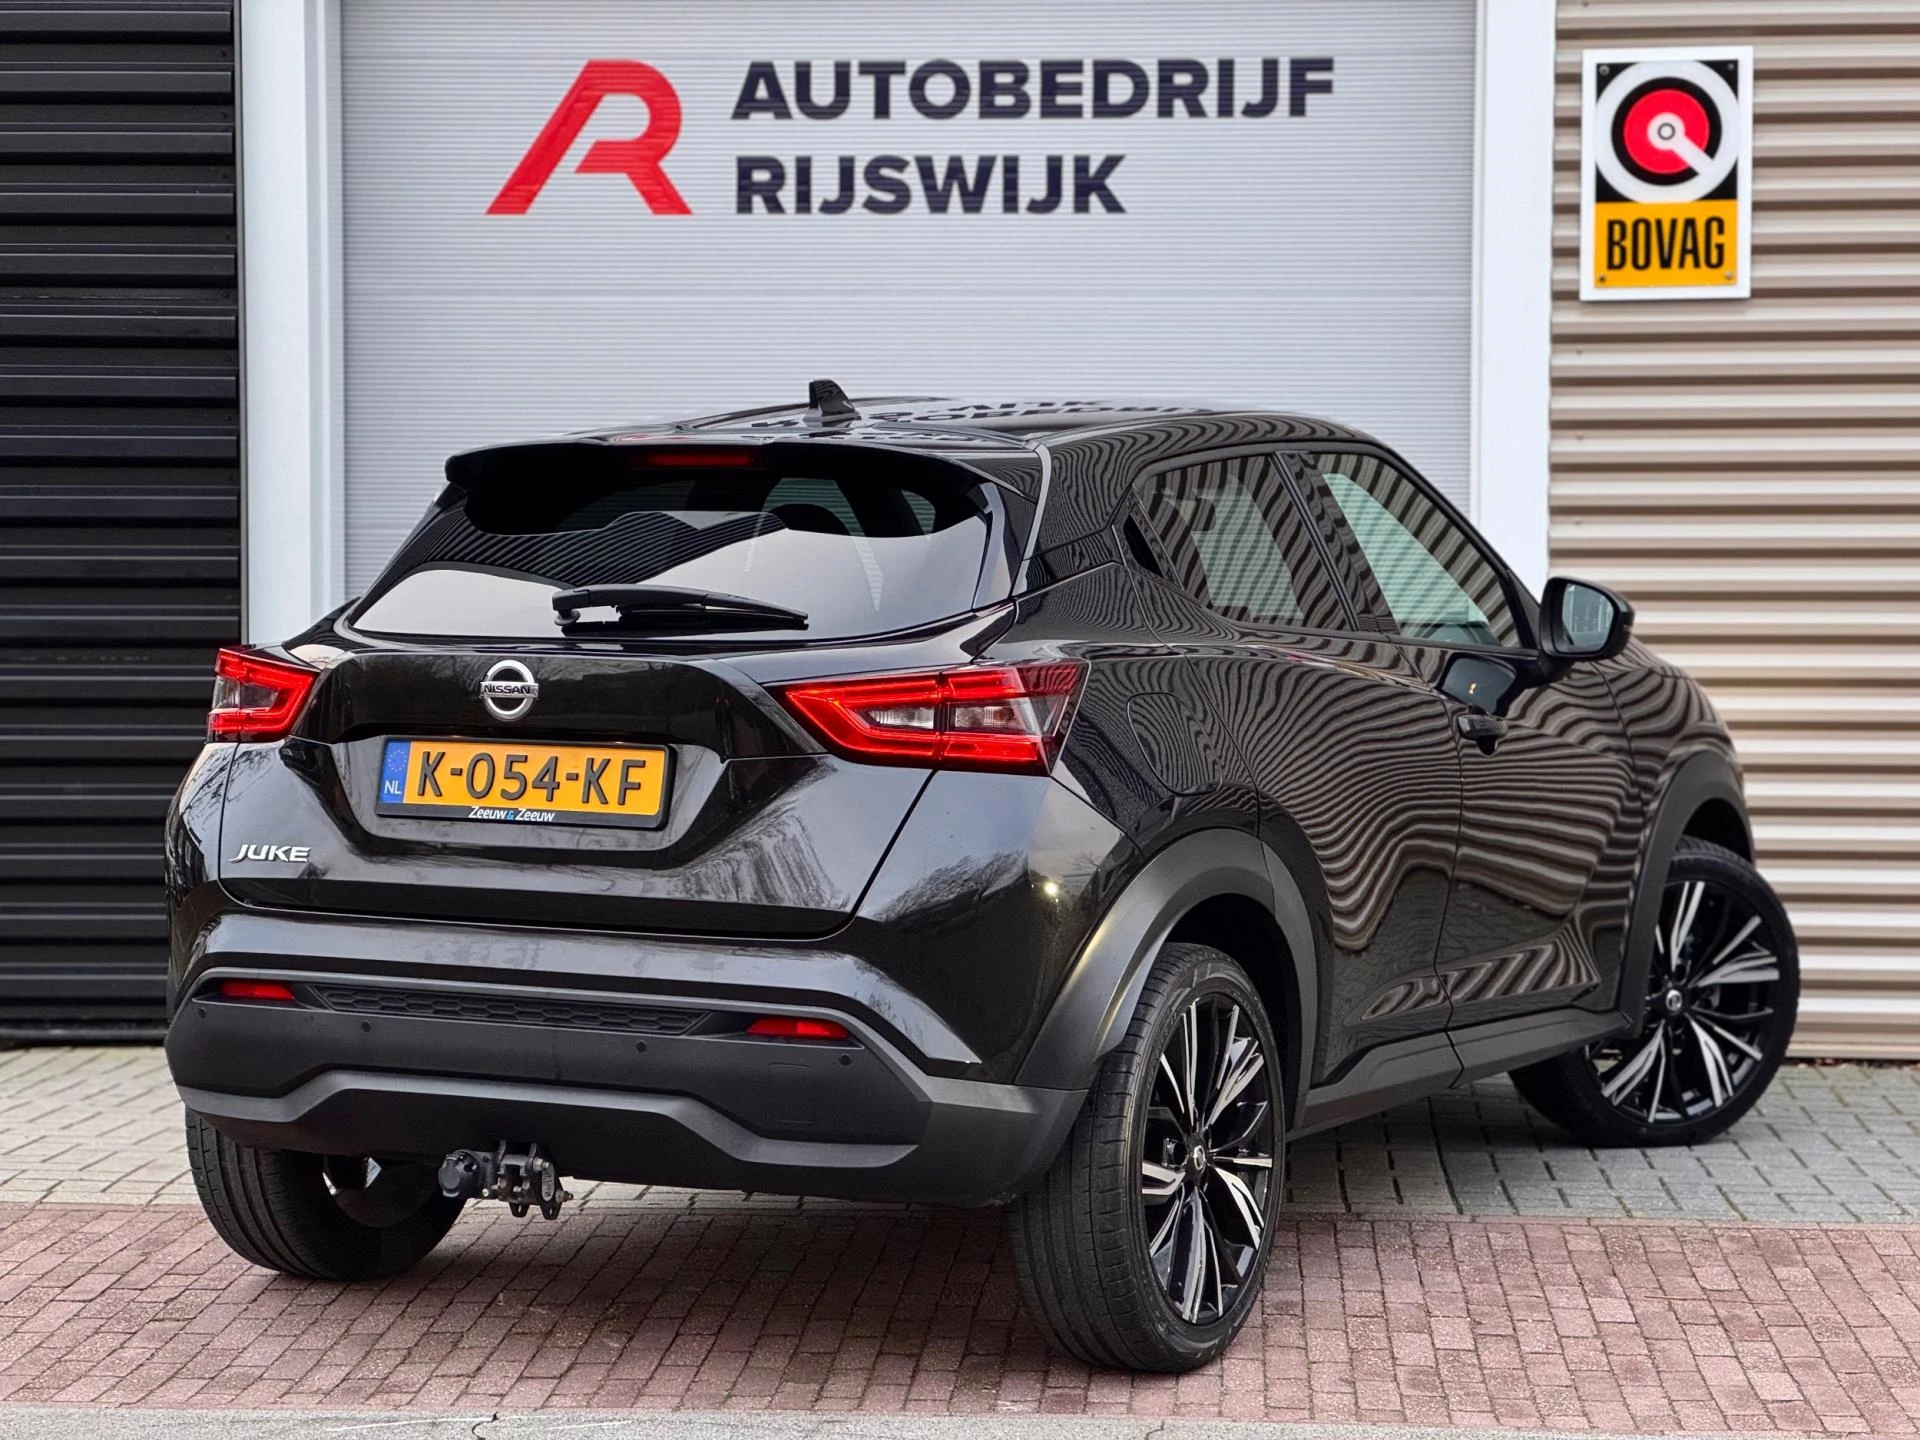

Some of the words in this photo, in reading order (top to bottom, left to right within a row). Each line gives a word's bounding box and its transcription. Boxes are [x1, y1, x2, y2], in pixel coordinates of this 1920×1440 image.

[731, 56, 1334, 120] AUTOBEDRIJF
[735, 154, 1126, 215] RIJSWIJK
[1606, 216, 1725, 271] BOVAG
[483, 684, 531, 694] NISSAN
[384, 779, 402, 796] NL
[417, 750, 646, 806] K-054-KF
[228, 844, 312, 863] JUKE
